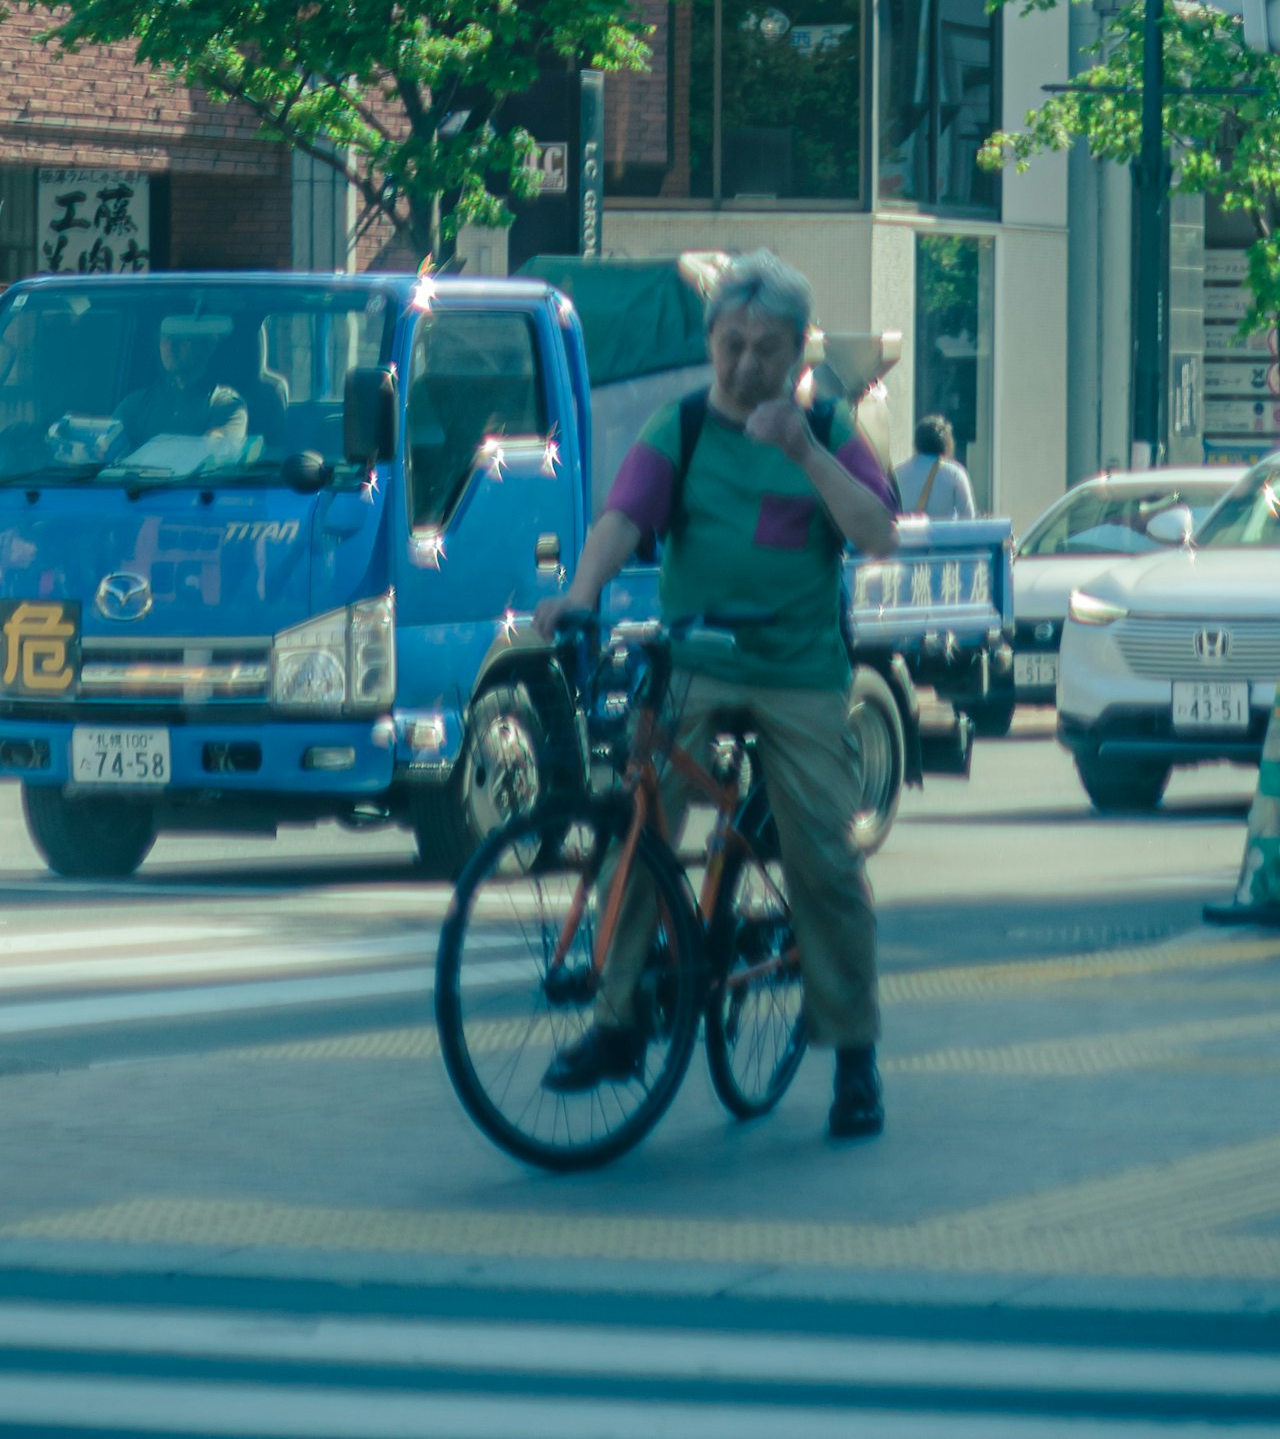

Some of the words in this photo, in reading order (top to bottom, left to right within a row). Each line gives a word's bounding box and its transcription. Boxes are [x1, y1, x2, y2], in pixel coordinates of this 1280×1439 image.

[49, 182, 138, 236] 工藤
[222, 519, 300, 545] TITAN
[2, 602, 75, 690] 危
[1189, 699, 1242, 721] 43-51
[125, 733, 149, 750] 100
[94, 750, 165, 780] 74-58
